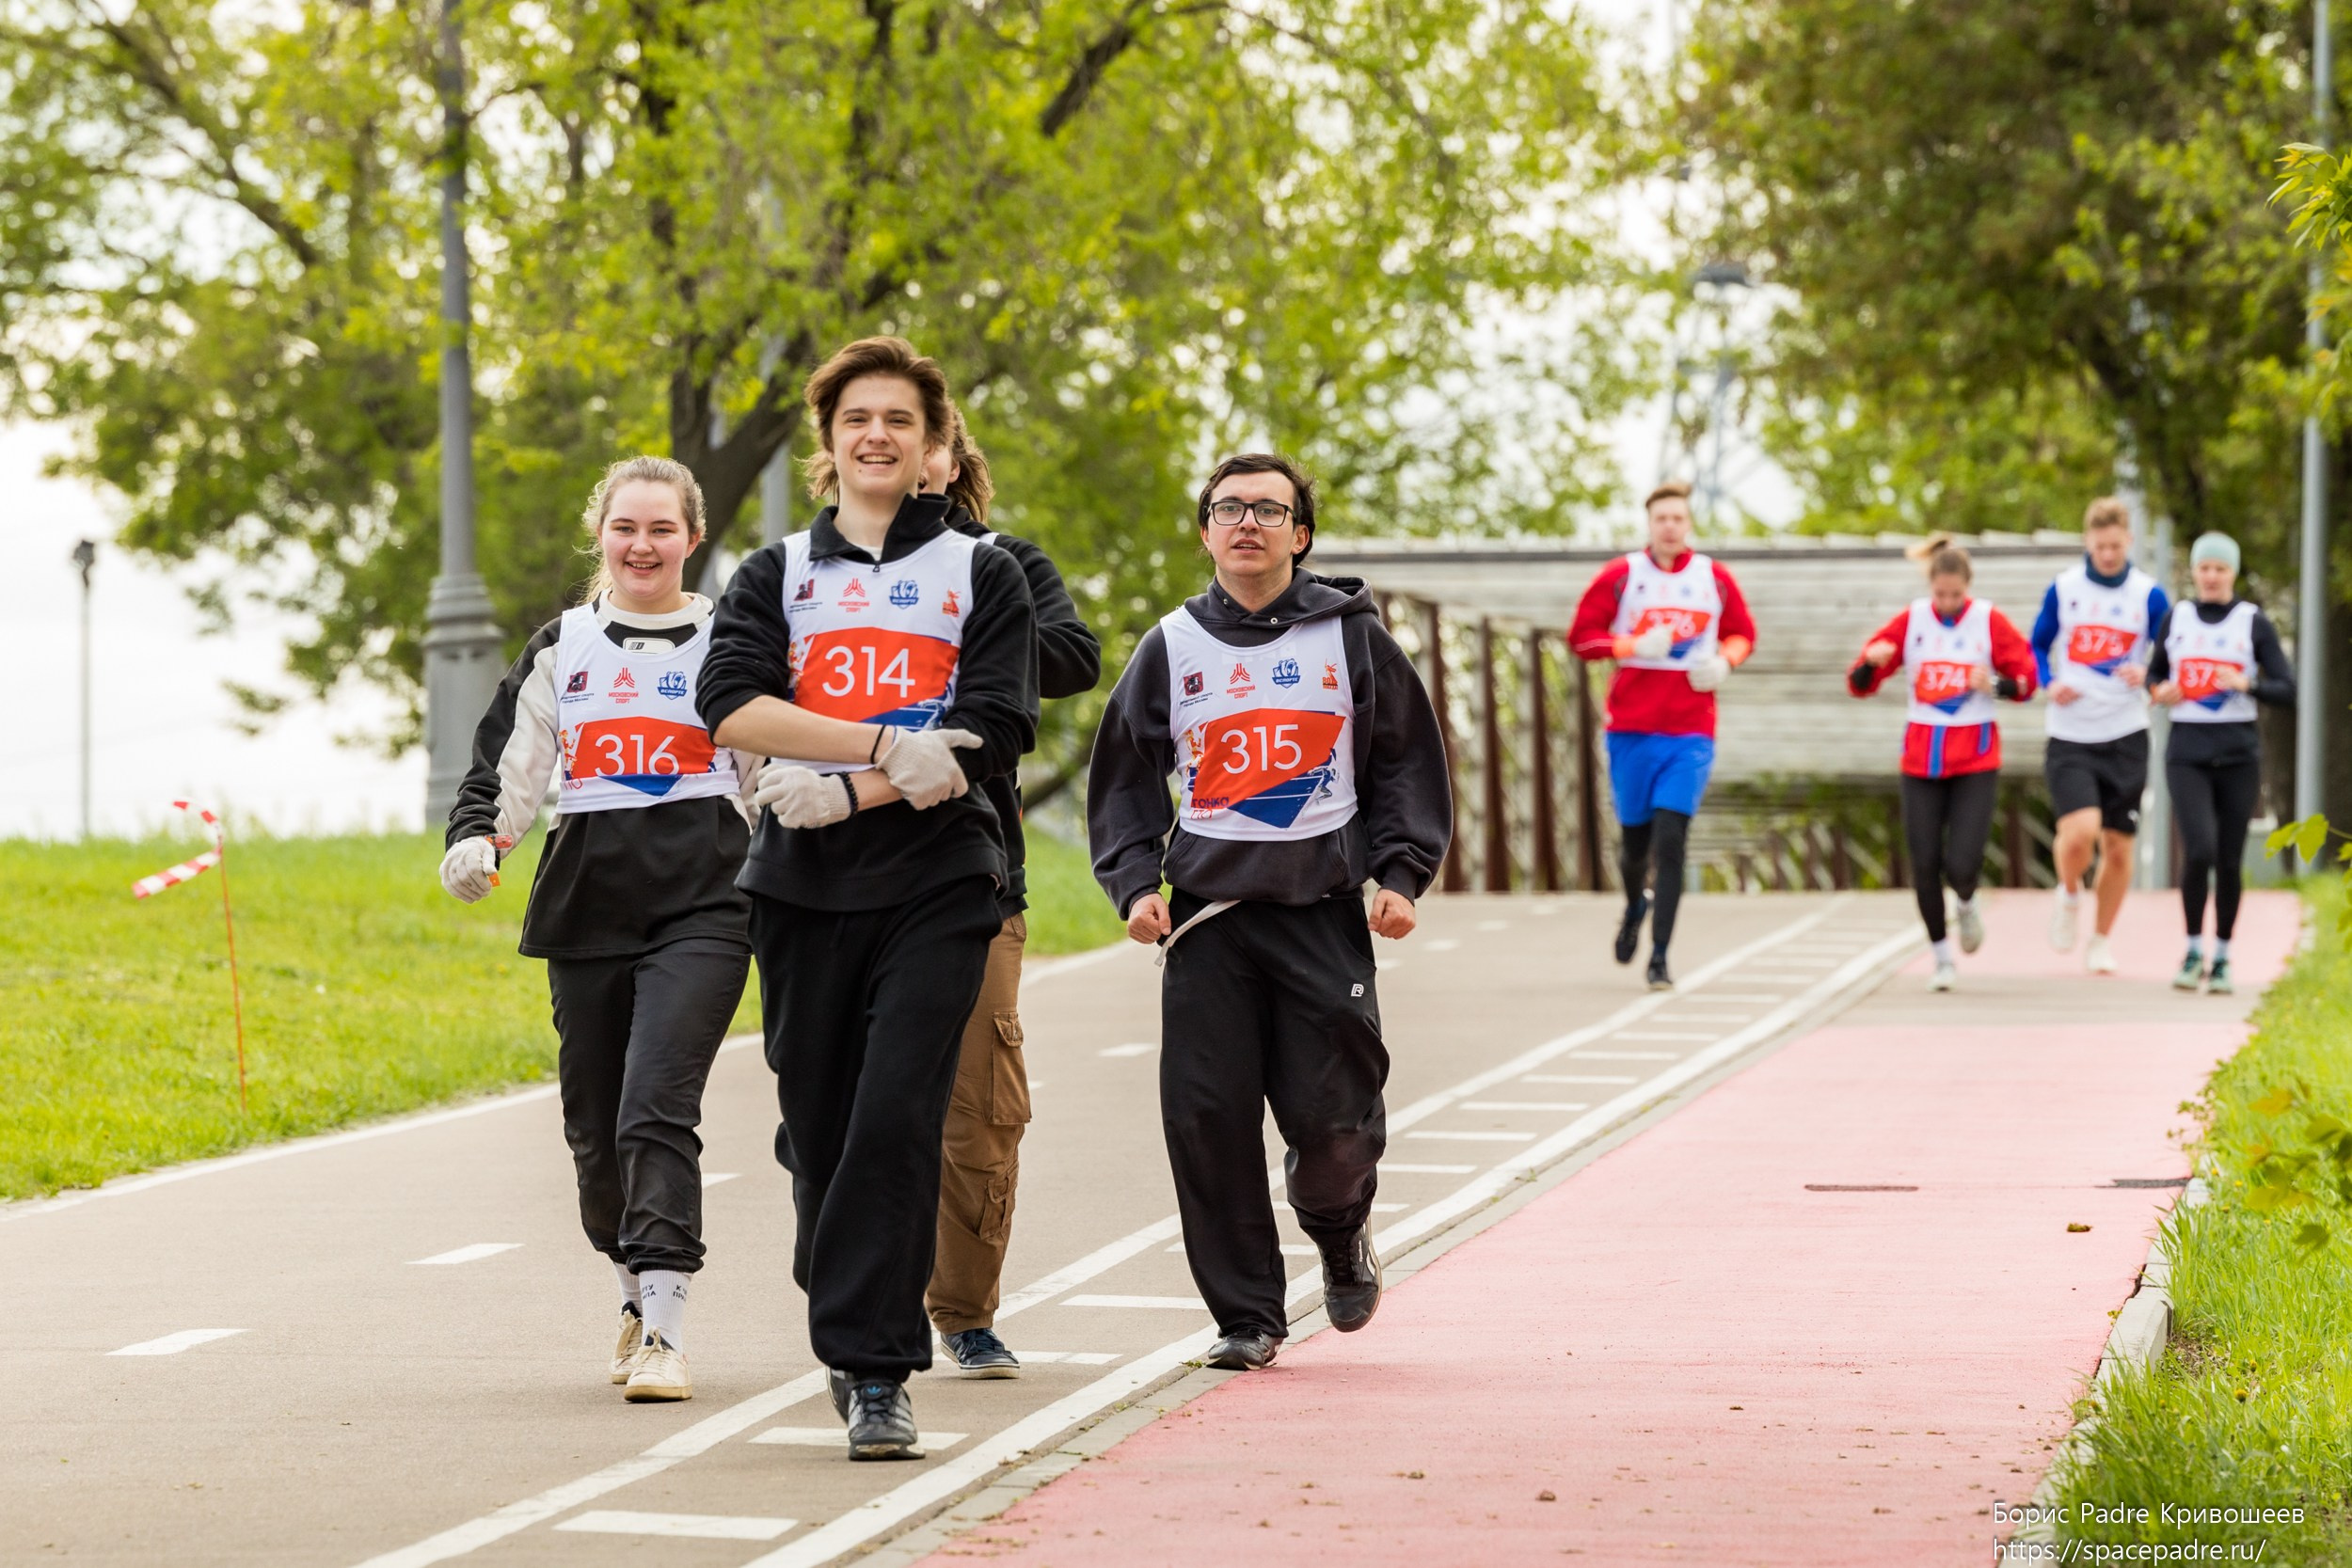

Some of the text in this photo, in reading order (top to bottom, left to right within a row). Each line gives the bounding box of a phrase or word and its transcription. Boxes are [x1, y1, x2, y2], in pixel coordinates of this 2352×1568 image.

[2075, 627, 2123, 657] 375
[822, 645, 915, 698] 314
[1226, 685, 1256, 694] МОСКОВСКИЙ
[1924, 664, 1967, 692] 374
[595, 734, 679, 776] 316
[1220, 723, 1302, 774] 315
